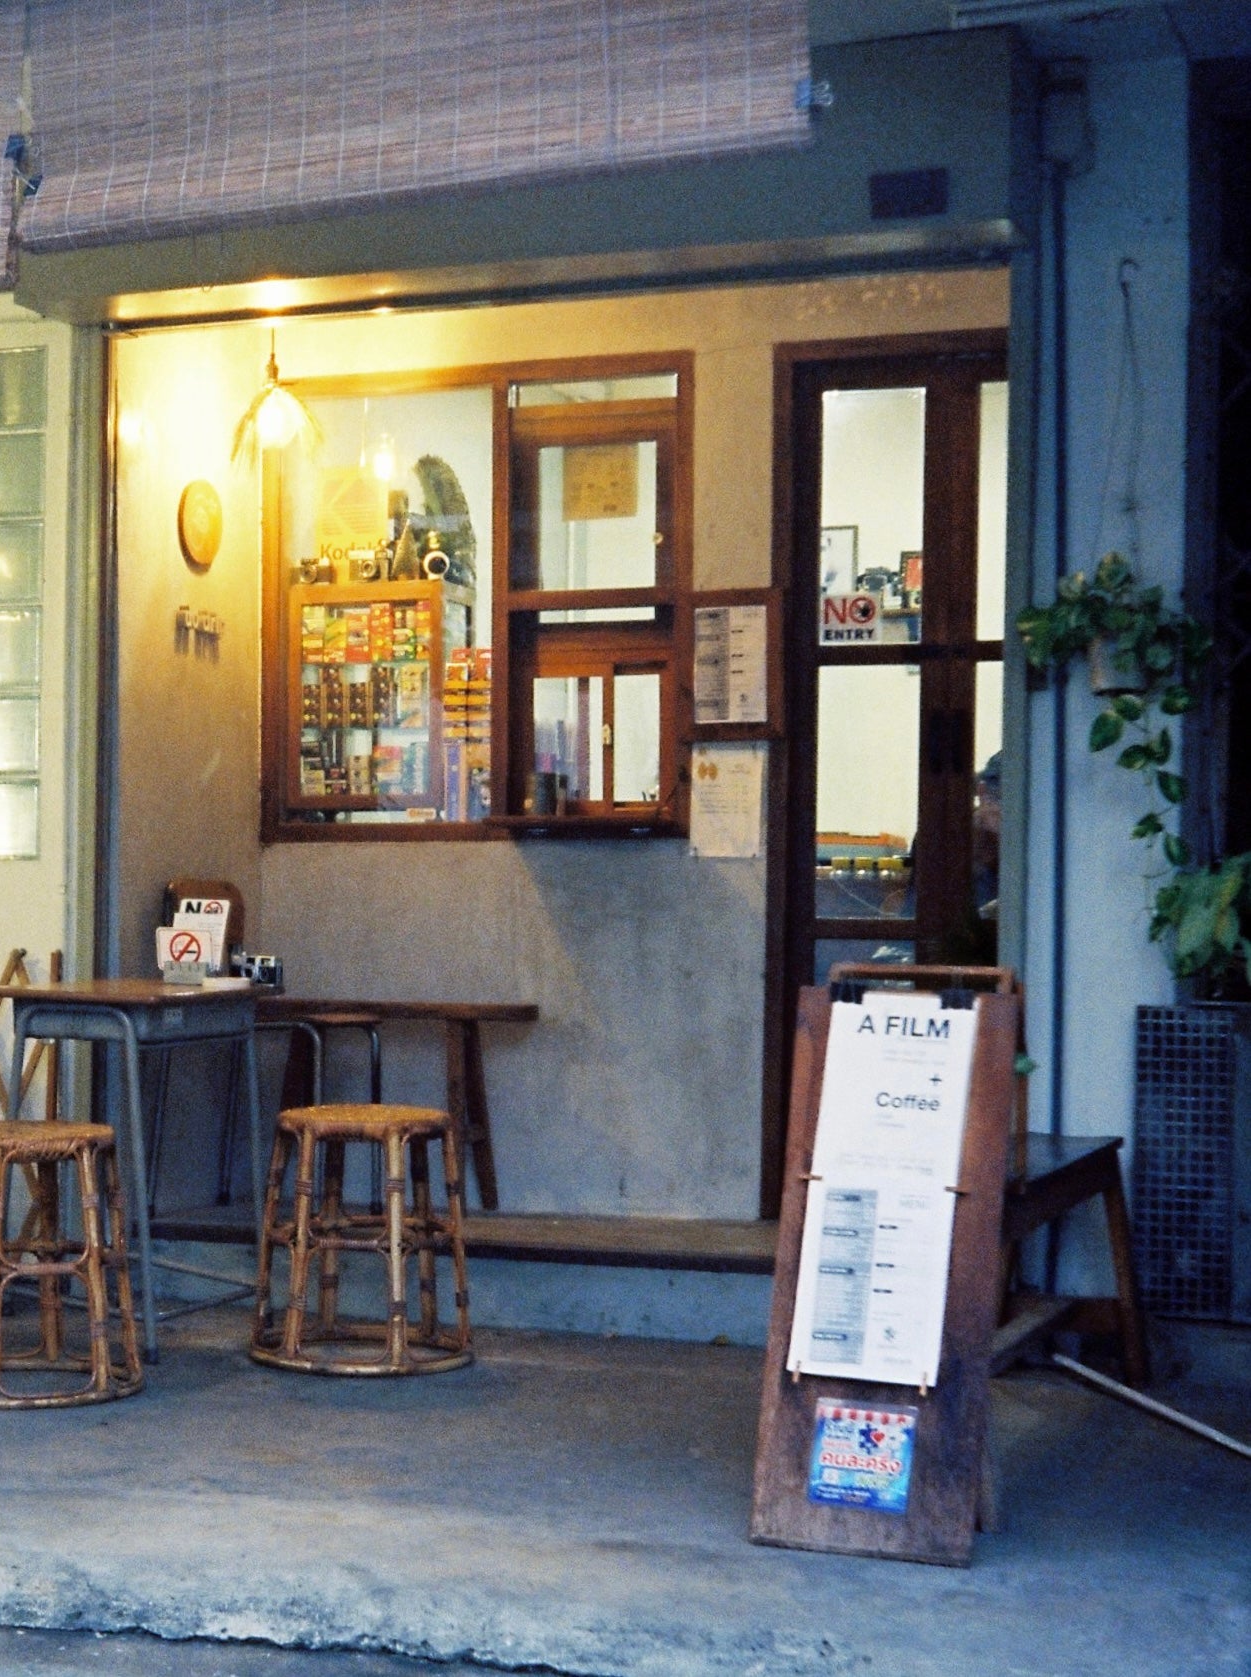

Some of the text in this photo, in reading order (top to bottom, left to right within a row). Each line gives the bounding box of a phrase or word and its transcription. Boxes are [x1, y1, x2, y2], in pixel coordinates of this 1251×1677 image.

[825, 628, 874, 641] ENTRY
[857, 1014, 949, 1038] A FILM
[875, 1091, 941, 1111] Coffee
